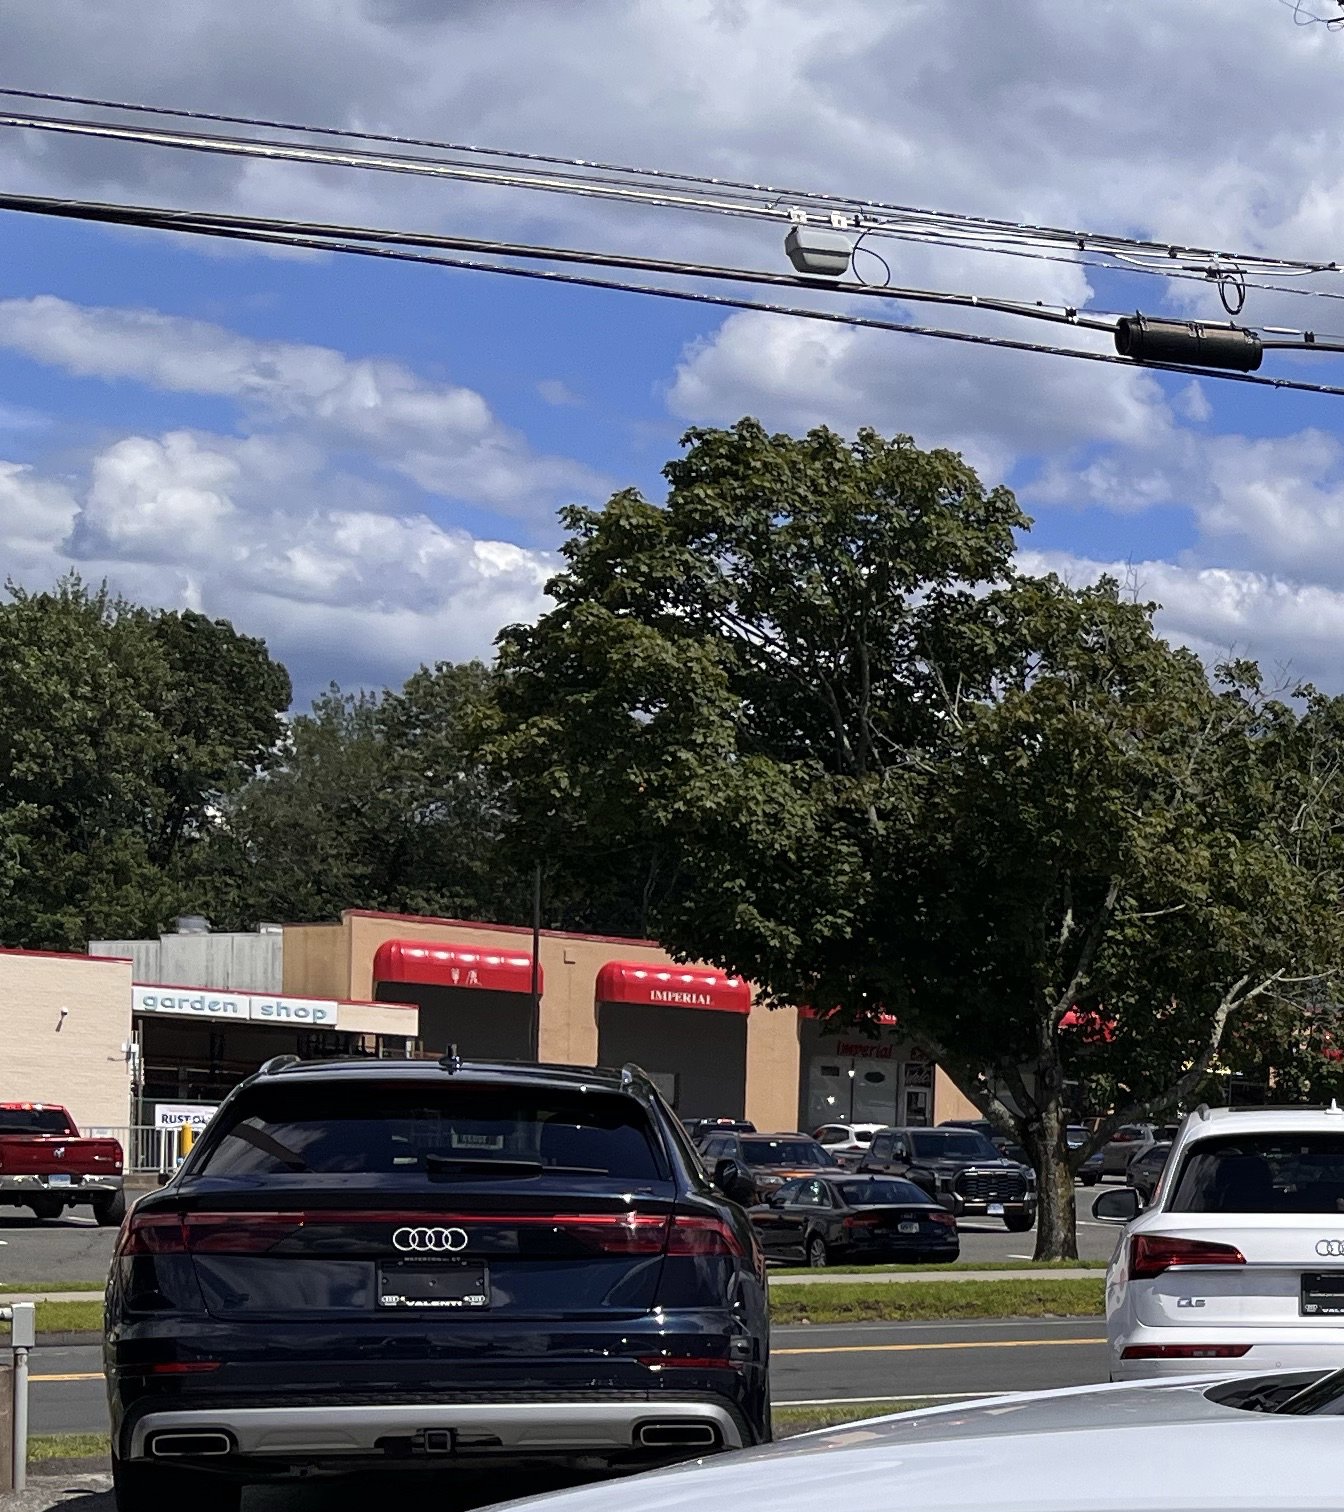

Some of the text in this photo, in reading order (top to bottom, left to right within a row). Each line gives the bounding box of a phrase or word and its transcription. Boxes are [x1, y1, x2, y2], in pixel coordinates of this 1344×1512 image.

[650, 989, 713, 1006] IMPERIAL
[142, 995, 327, 1024] garden shop
